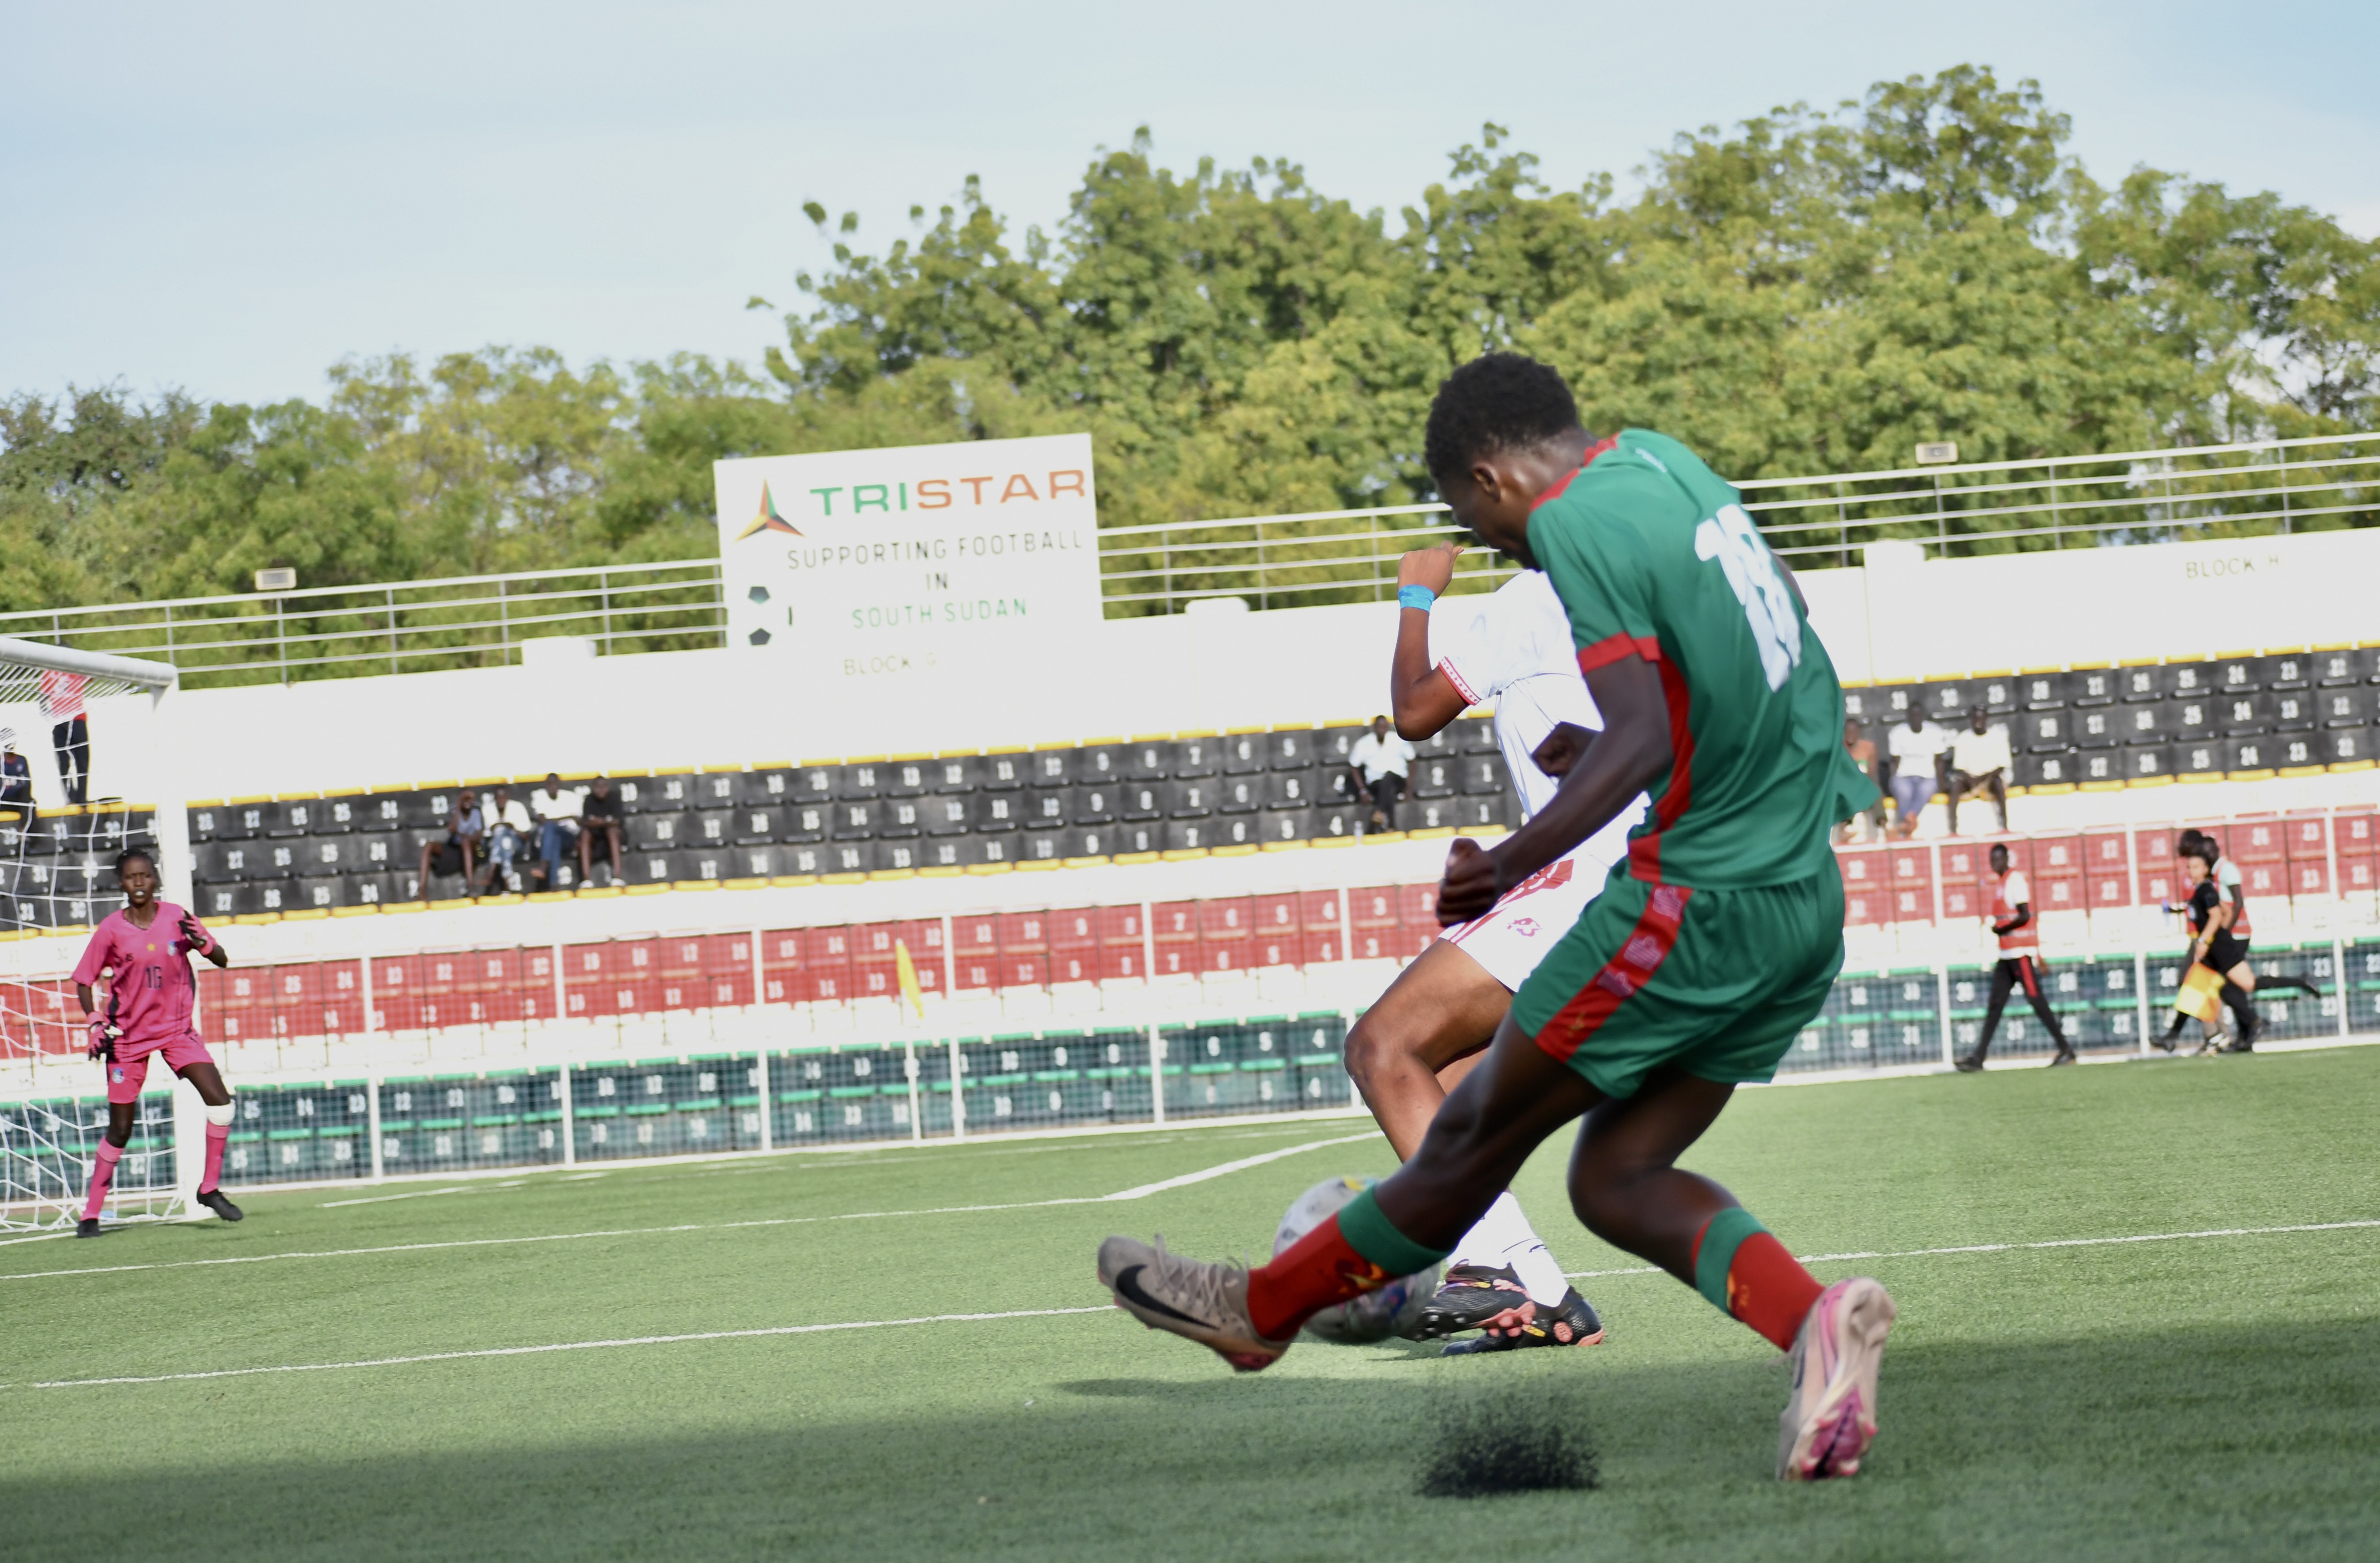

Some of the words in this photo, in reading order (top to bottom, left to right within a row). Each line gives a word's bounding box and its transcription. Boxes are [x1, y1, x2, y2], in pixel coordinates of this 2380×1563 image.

[809, 469, 1085, 516] TRISTAR
[788, 538, 947, 569] SUPPORTING
[958, 530, 1082, 556] FOOTBALL
[2186, 557, 2255, 579] BLOCK
[2268, 555, 2279, 566] H
[926, 573, 948, 590] IN
[852, 605, 932, 629] SOUTH
[944, 598, 1026, 622] SUDAN
[844, 655, 912, 676] BLOCK
[1337, 736, 1348, 753] 4
[1482, 726, 1492, 744] 1
[1190, 747, 1200, 764] 7
[1284, 739, 1295, 756] 5
[1482, 763, 1492, 782] 1
[1189, 788, 1200, 807] 7
[1287, 779, 1299, 798] 5
[1480, 805, 1488, 822] 1
[1281, 819, 1294, 838] 5
[1330, 817, 1342, 834] 4
[1186, 829, 1197, 846] 7
